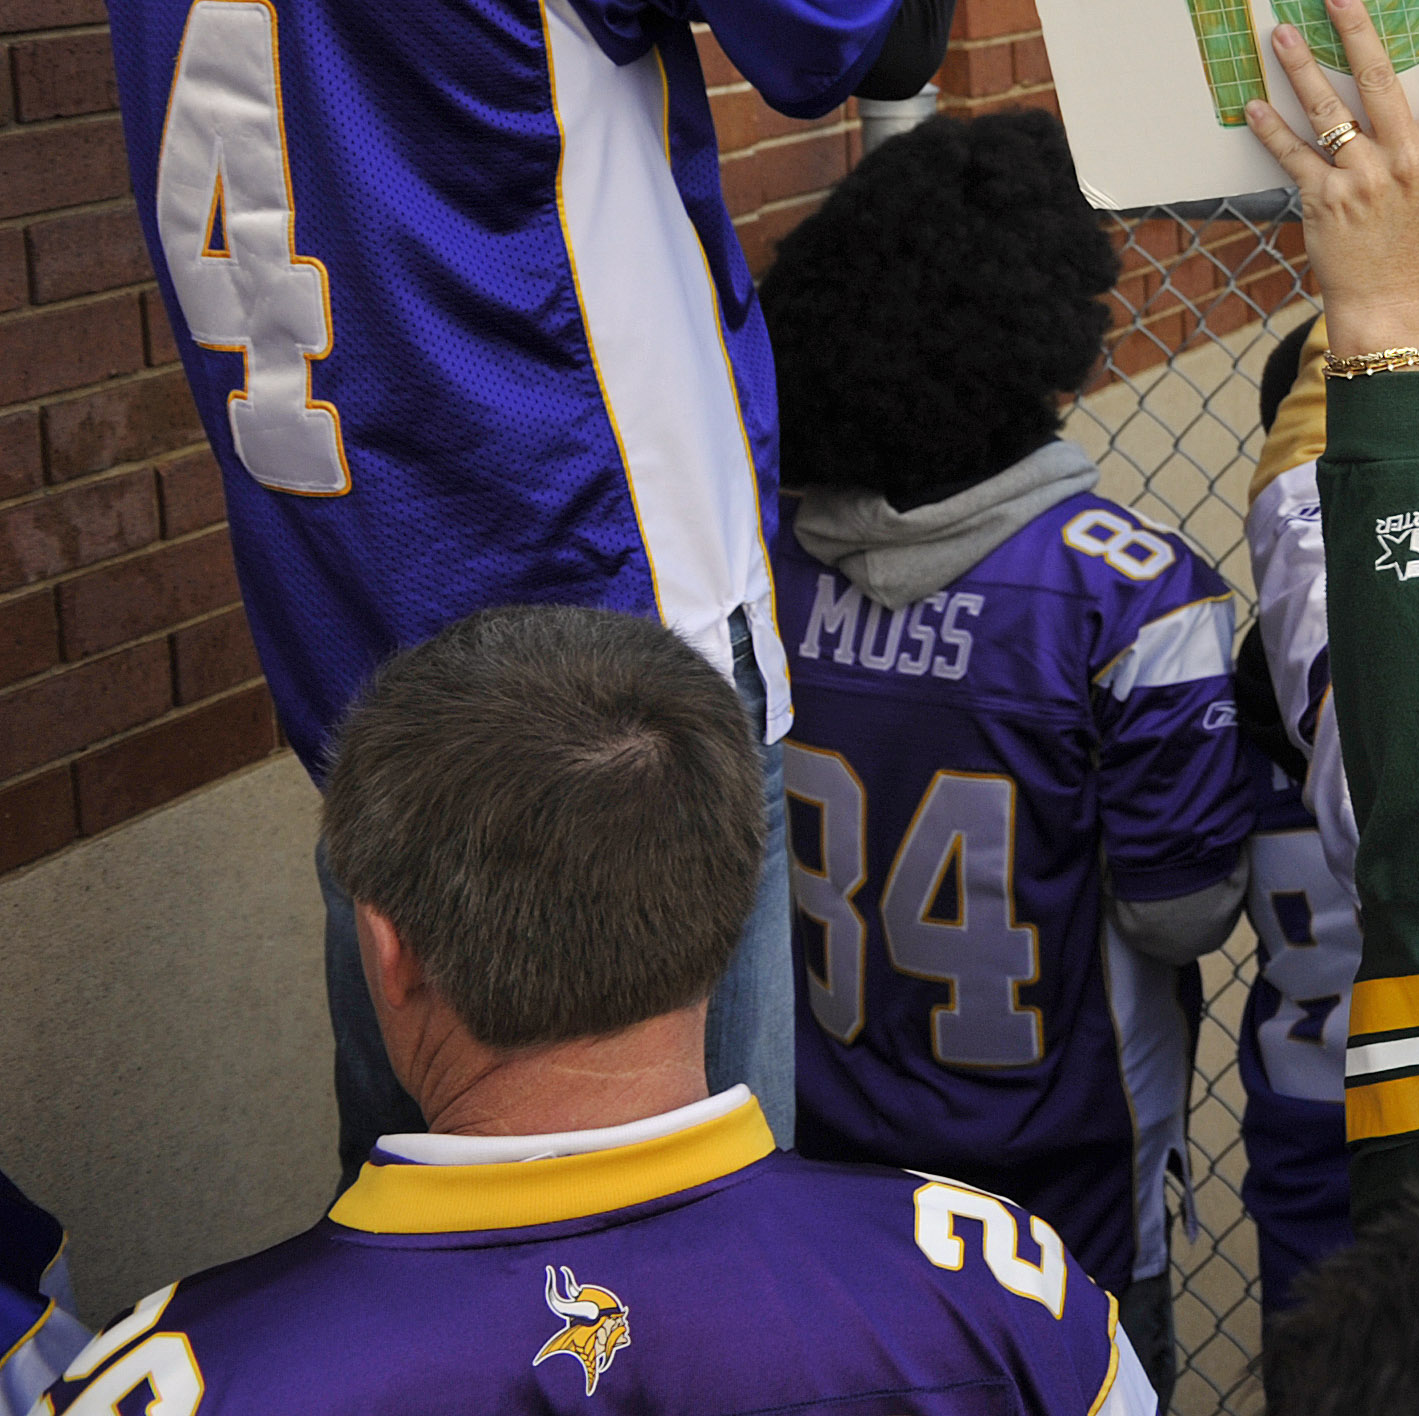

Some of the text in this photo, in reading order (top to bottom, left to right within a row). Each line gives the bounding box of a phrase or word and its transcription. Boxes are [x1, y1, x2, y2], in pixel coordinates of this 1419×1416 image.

[1062, 506, 1218, 582] 8
[799, 575, 985, 681] MOSS
[904, 1169, 1067, 1320] 2
